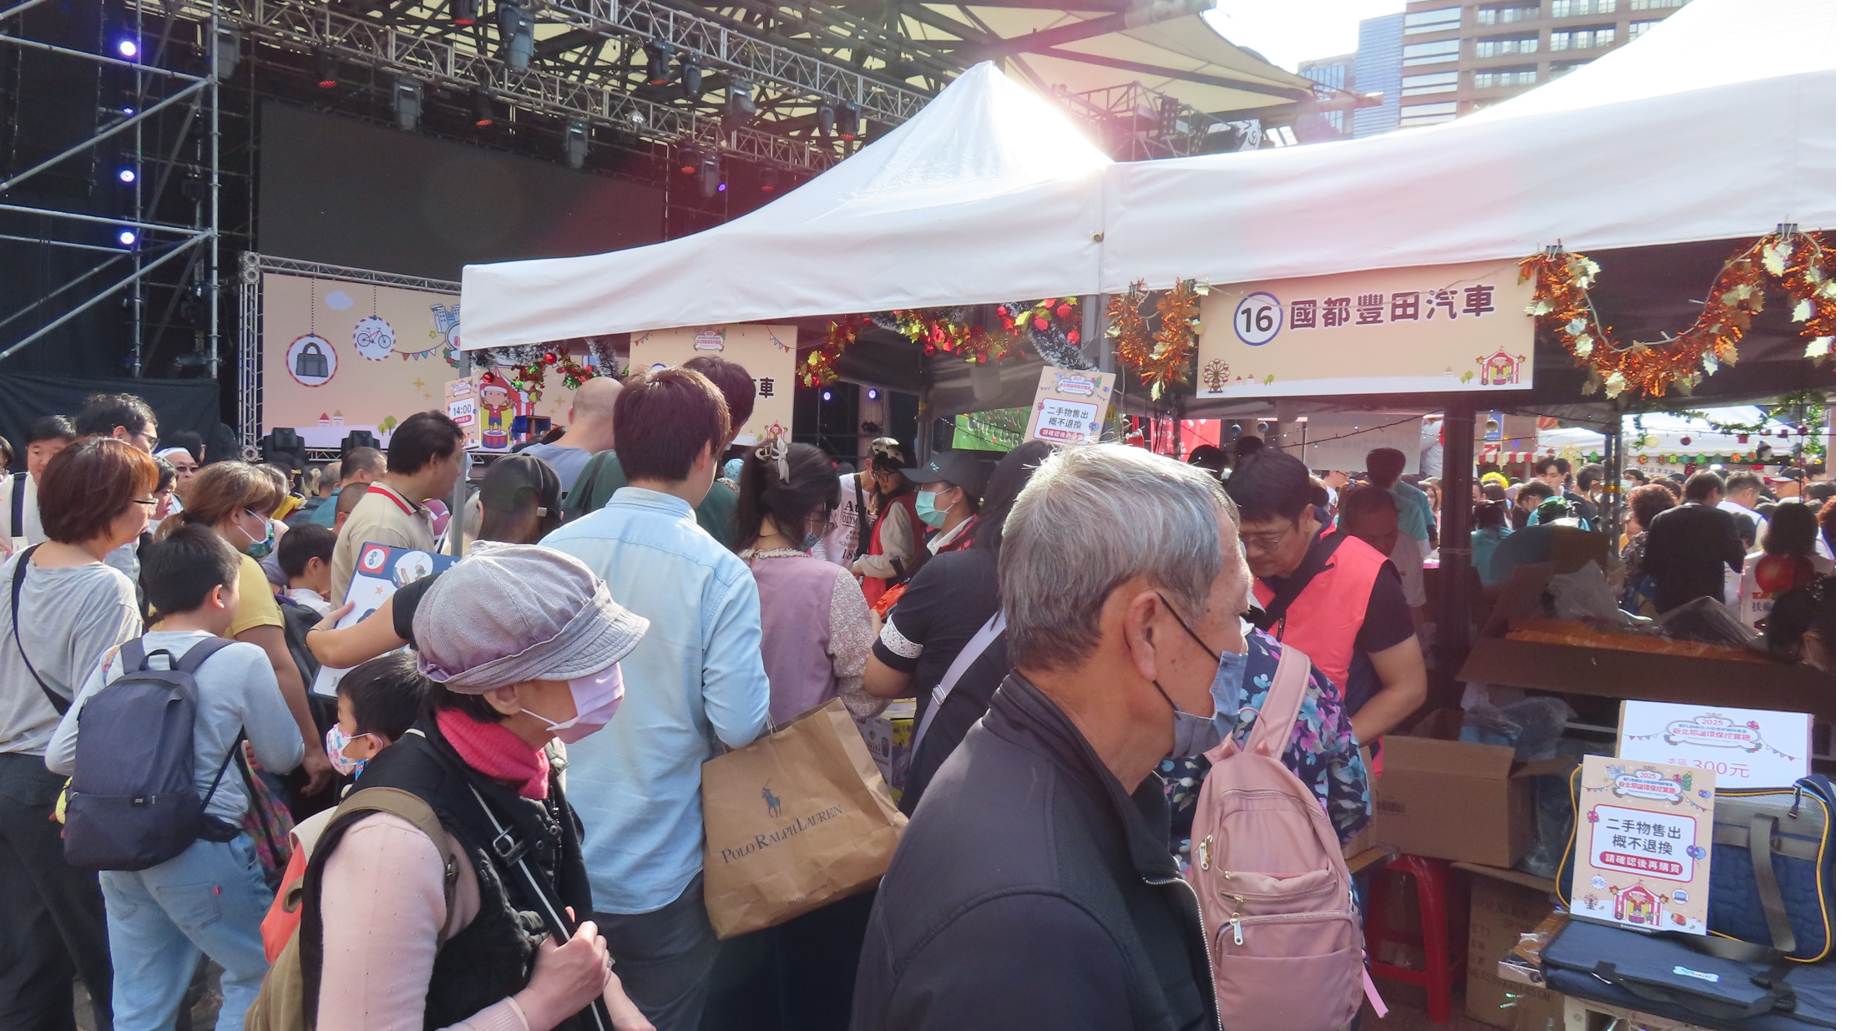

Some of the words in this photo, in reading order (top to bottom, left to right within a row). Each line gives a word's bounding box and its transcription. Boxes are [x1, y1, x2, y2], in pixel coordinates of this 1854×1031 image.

[1290, 284, 1495, 330] 國都豐田汽車
[1240, 305, 1274, 333] 16
[1047, 406, 1089, 420] 二手物售出
[755, 824, 799, 850] RALPH
[796, 804, 844, 833] LAUREN
[1606, 818, 1681, 840] 二手物售出
[1612, 834, 1673, 855] 概不退換
[1604, 853, 1681, 874] 請確認後再購買
